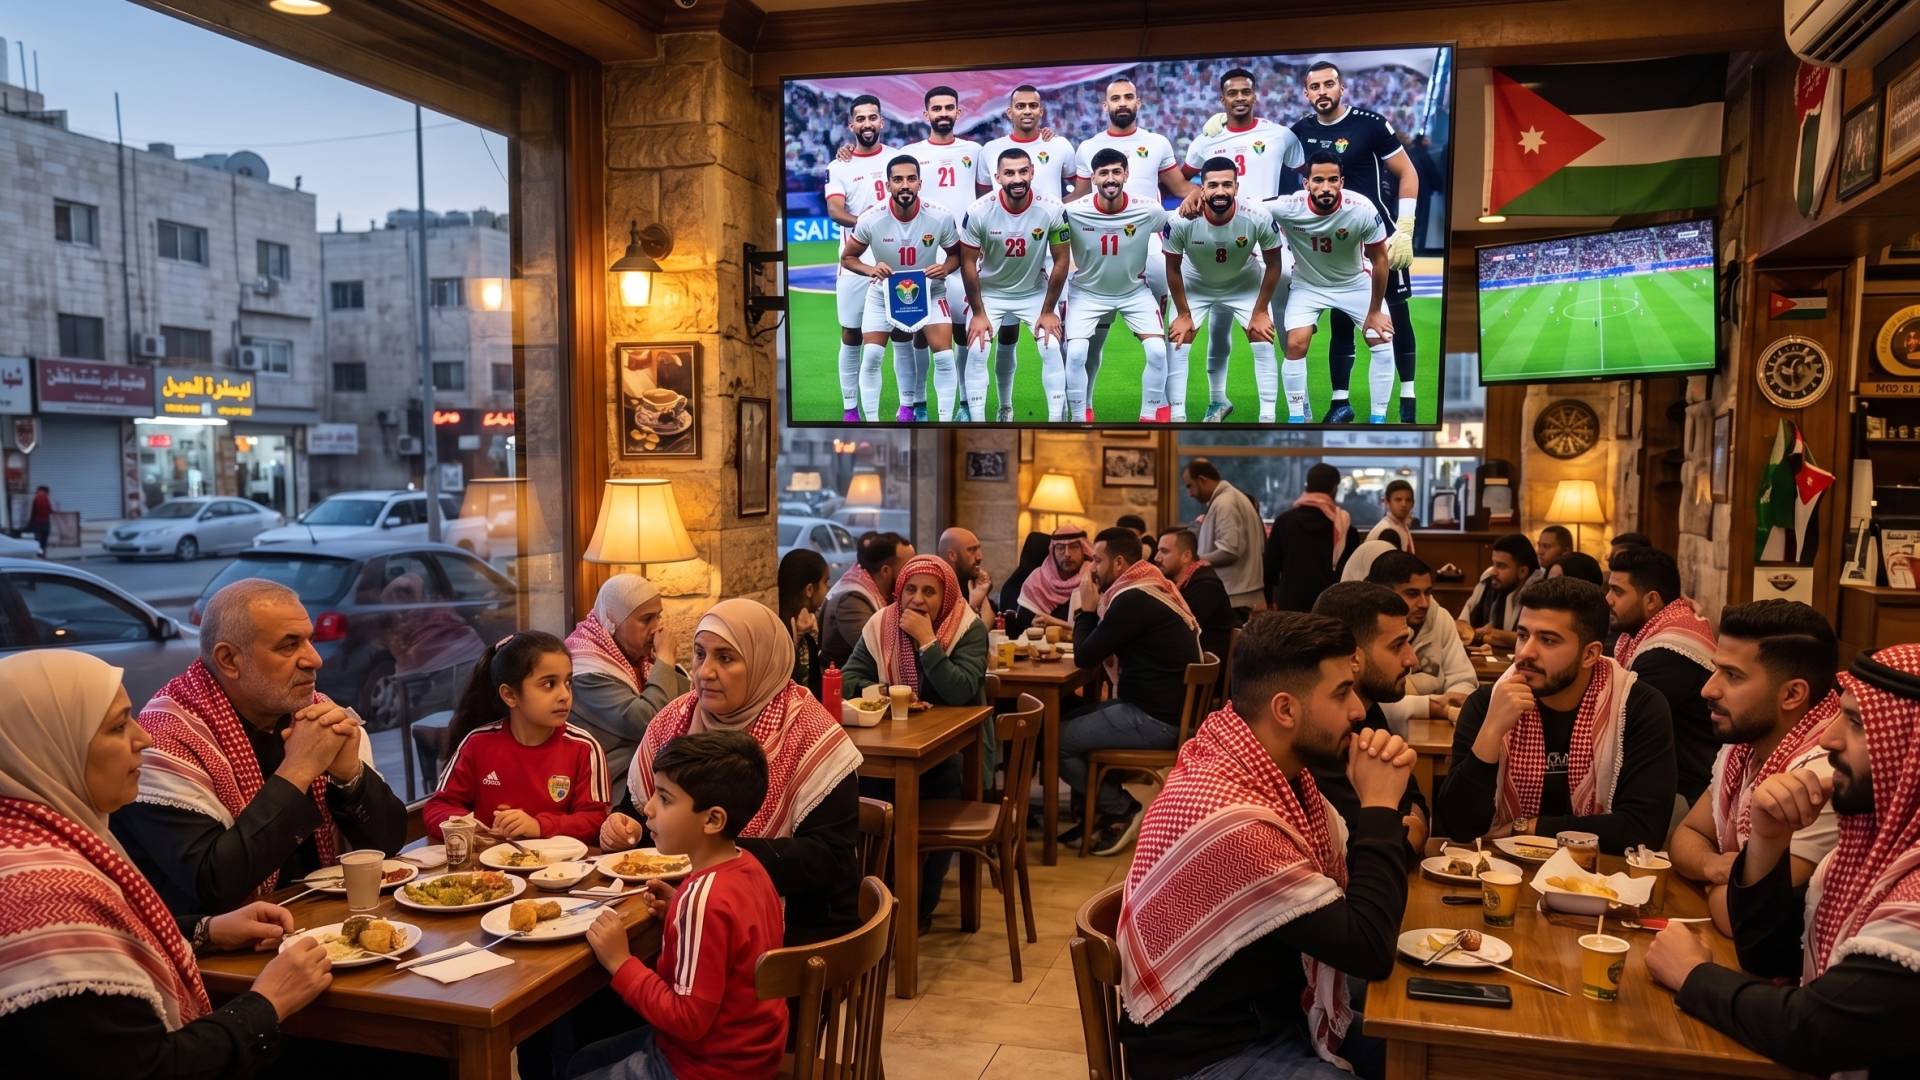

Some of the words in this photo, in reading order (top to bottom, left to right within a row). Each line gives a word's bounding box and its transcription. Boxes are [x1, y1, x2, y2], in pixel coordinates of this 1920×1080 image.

[1235, 154, 1246, 176] 3
[938, 167, 956, 187] 21
[875, 180, 886, 201] 9
[1004, 238, 1026, 257] 23
[1100, 234, 1119, 256] 11
[1310, 236, 1332, 254] 13
[898, 246, 917, 266] 10
[1215, 248, 1227, 264] 8
